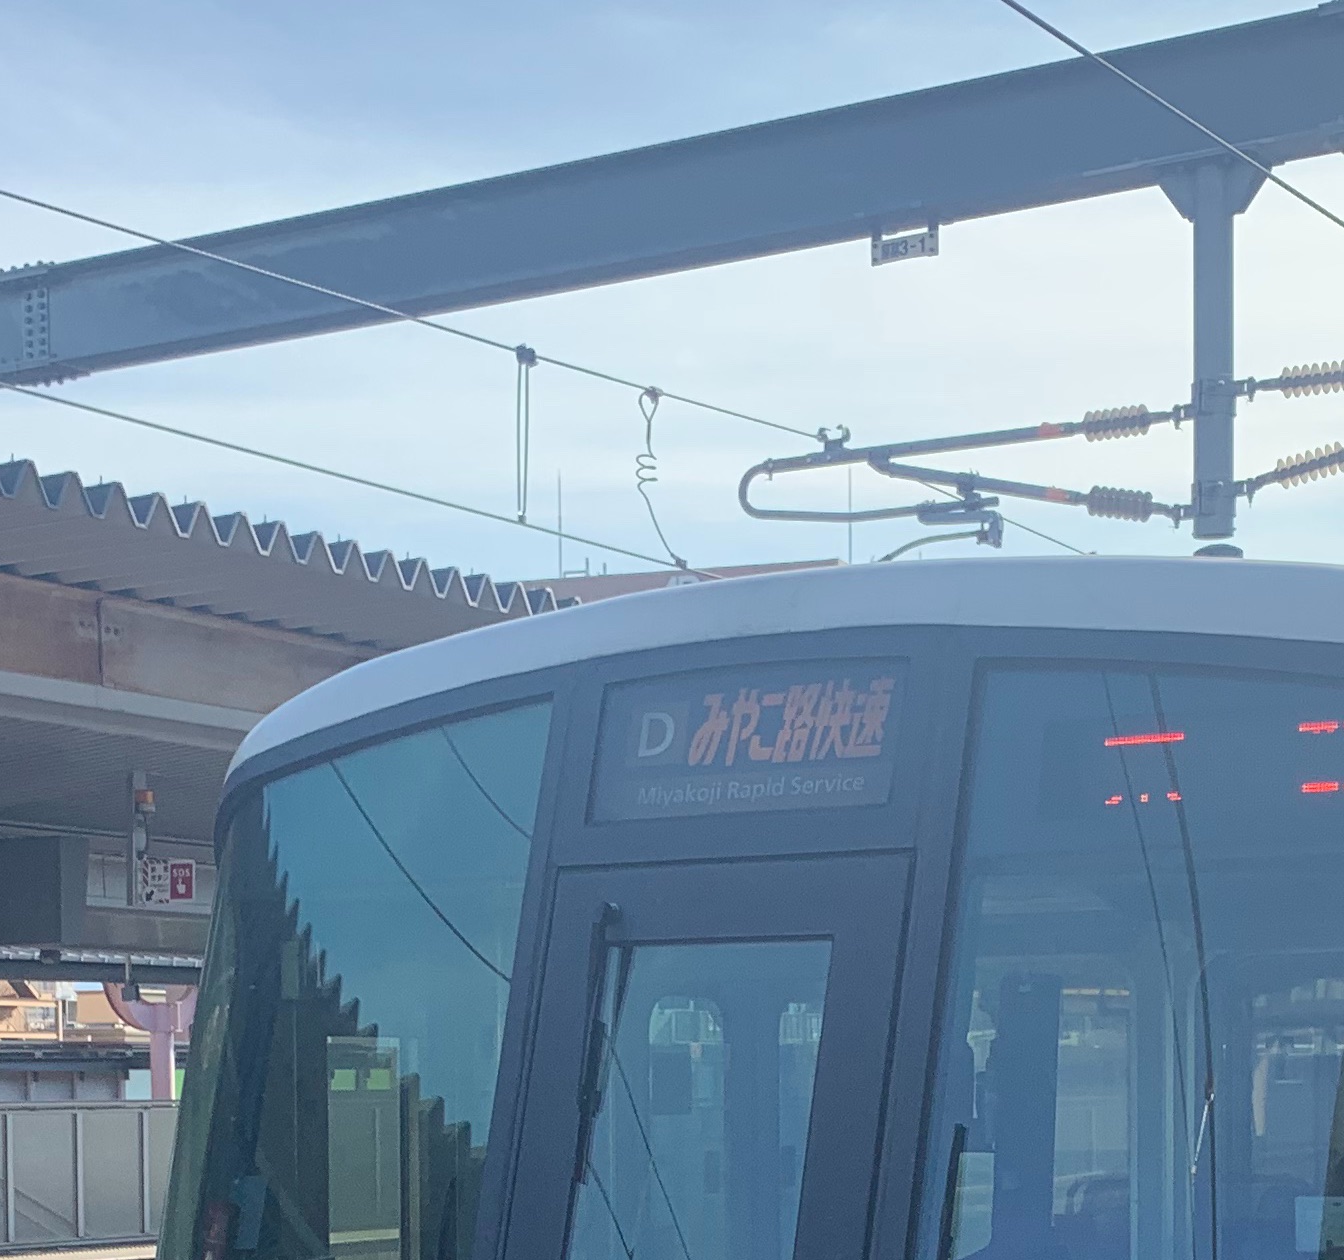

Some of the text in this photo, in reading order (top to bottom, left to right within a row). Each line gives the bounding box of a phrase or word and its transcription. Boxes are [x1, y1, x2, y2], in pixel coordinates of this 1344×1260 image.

[638, 711, 675, 758] D
[687, 677, 896, 767] みやこ路快速
[638, 773, 866, 806] Miyakoji Rapid Service
[172, 868, 191, 878] SOS
